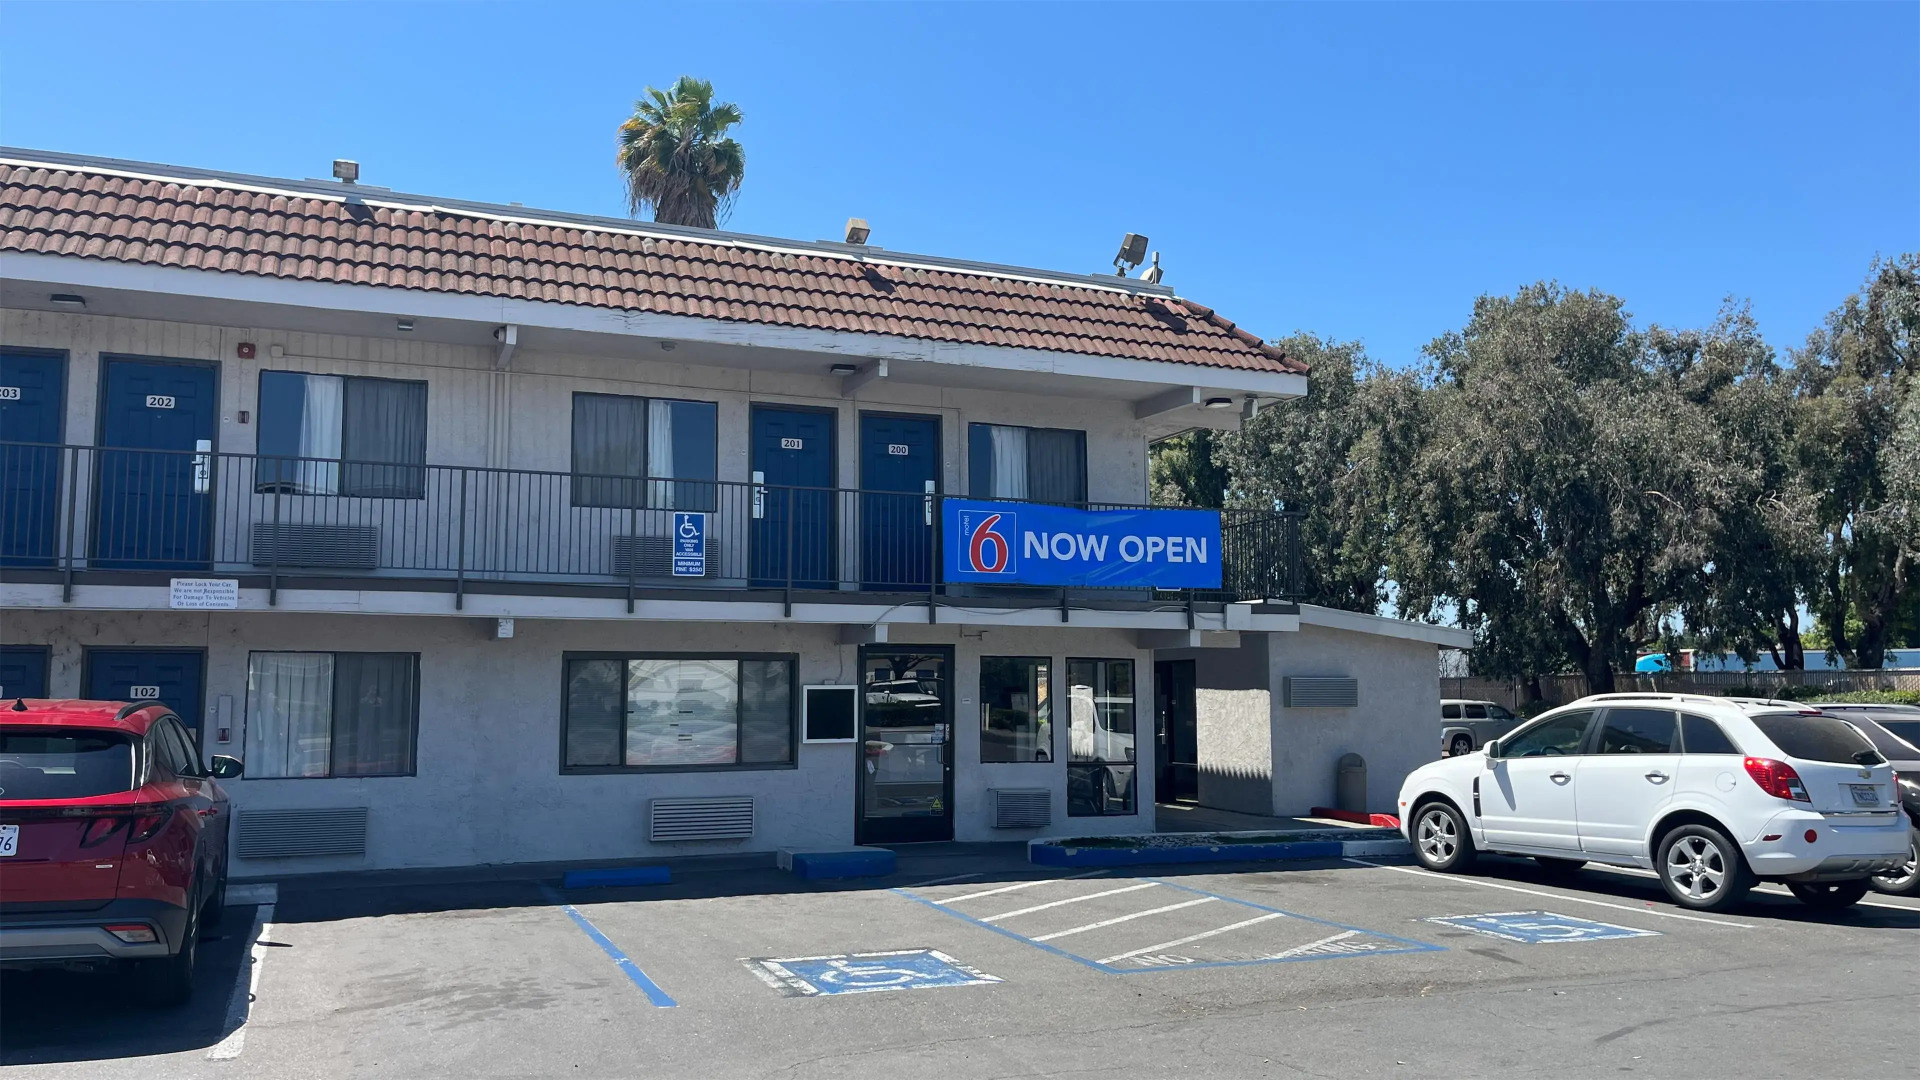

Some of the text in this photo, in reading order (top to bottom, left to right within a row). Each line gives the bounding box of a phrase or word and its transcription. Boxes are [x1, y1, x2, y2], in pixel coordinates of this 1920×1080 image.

[0, 388, 18, 399] 03
[149, 397, 172, 407] 202
[784, 440, 800, 448] 201
[890, 446, 907, 454] 200
[969, 514, 1009, 572] 6
[1024, 531, 1208, 564] NOW OPEN
[134, 687, 156, 697] 102
